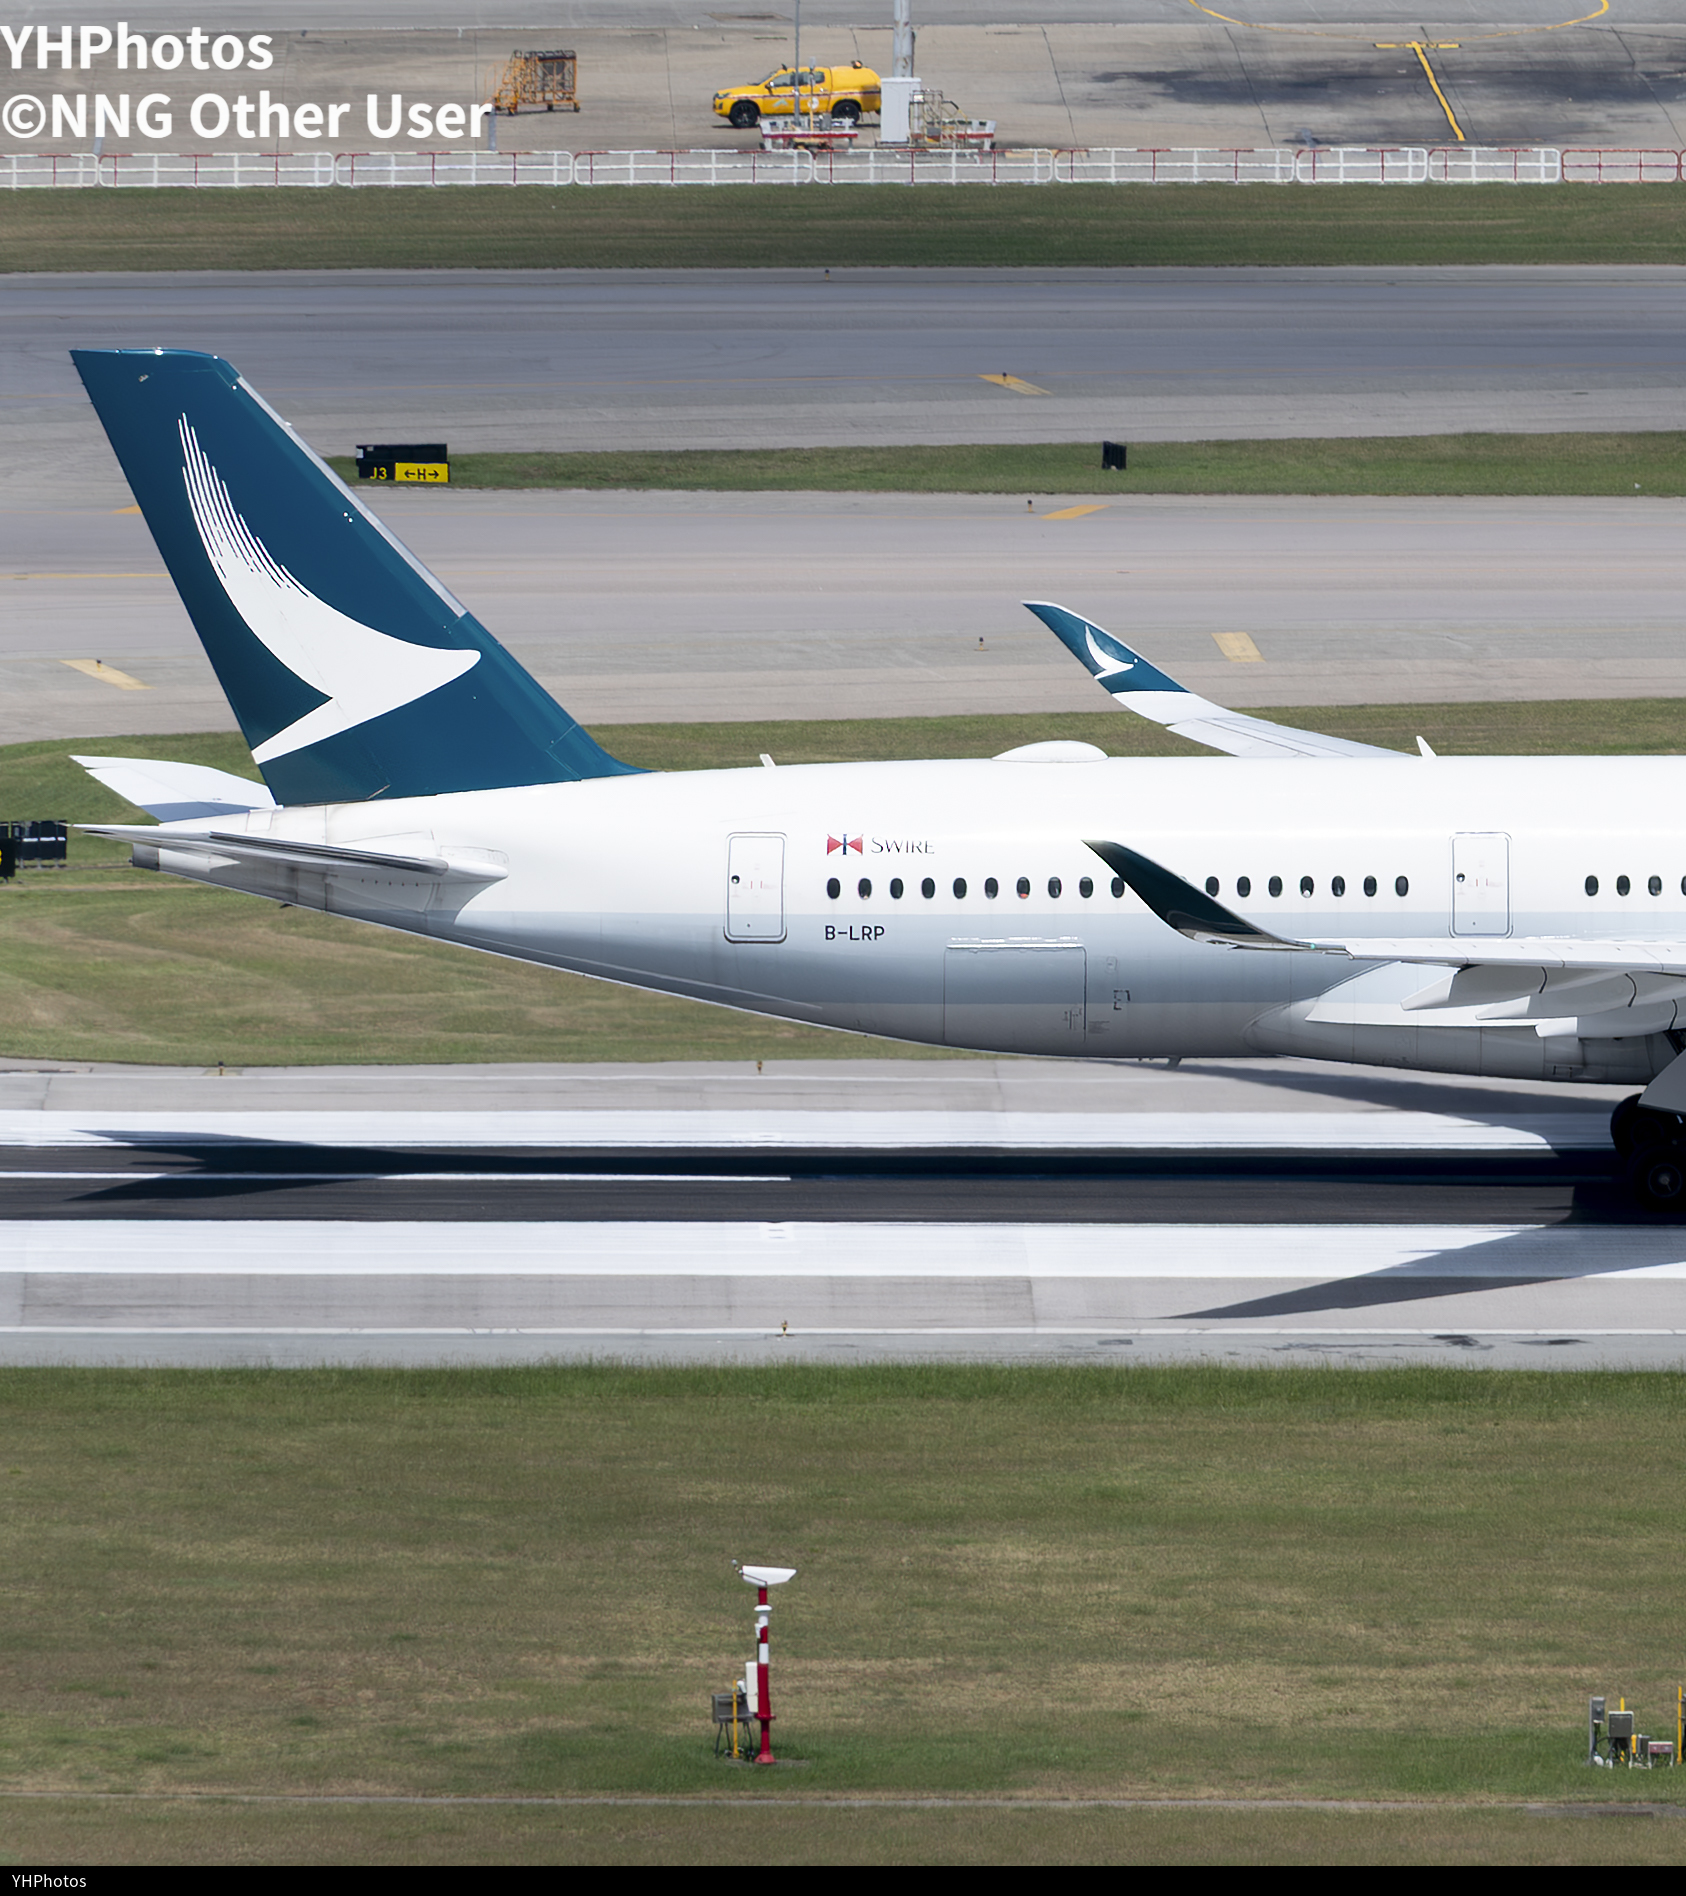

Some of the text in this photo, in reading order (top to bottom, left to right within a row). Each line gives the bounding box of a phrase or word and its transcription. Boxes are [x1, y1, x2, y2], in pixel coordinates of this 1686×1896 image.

[369, 467, 426, 480] J3 H
[825, 925, 885, 941] B-LRP
